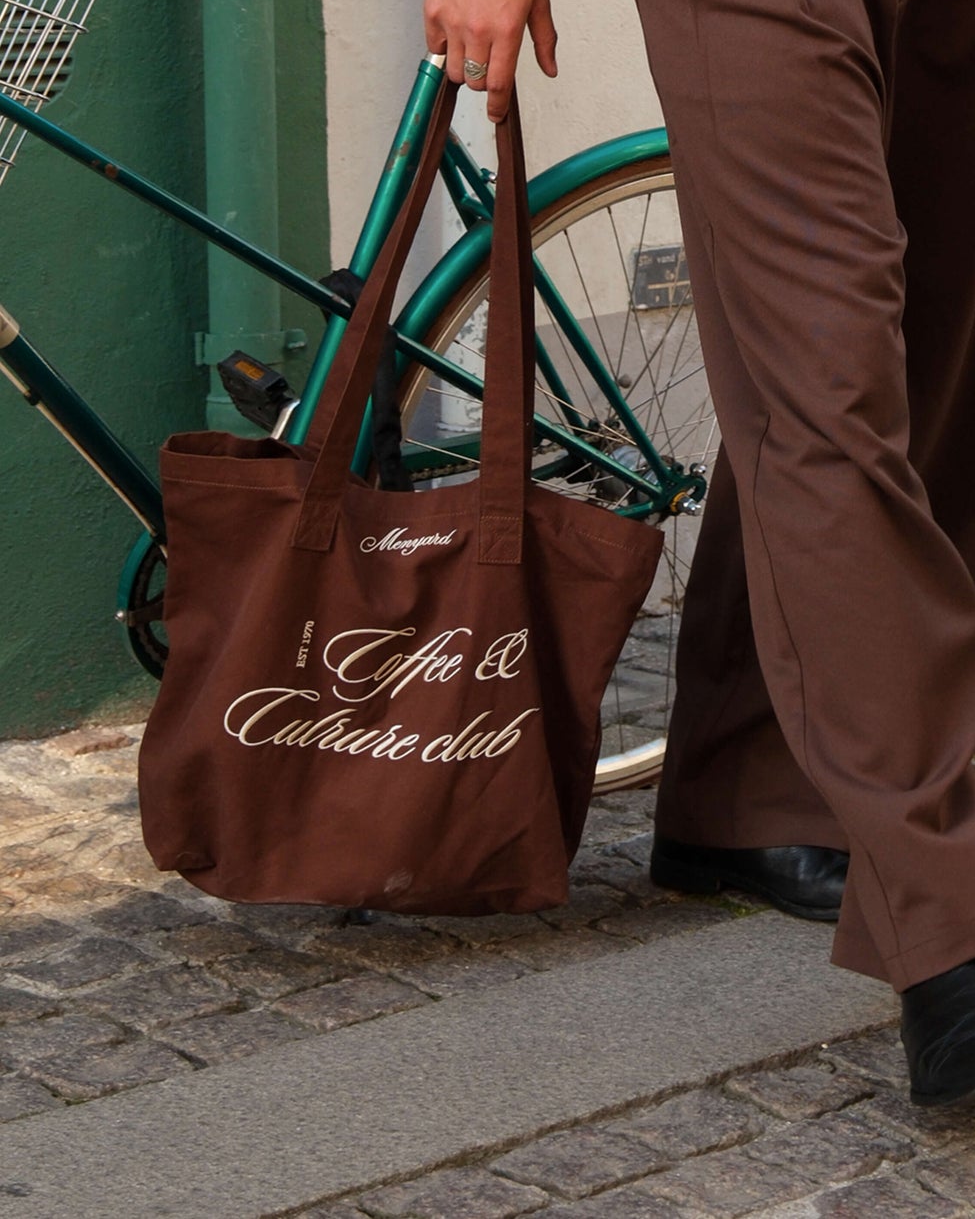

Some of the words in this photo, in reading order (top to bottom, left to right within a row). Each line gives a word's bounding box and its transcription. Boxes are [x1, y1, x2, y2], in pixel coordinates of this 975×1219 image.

[360, 527, 457, 556] Menyard
[302, 620, 315, 645] 1970
[296, 645, 309, 669] EST
[323, 627, 472, 702] Coffee
[475, 628, 529, 681] &
[421, 707, 541, 763] club
